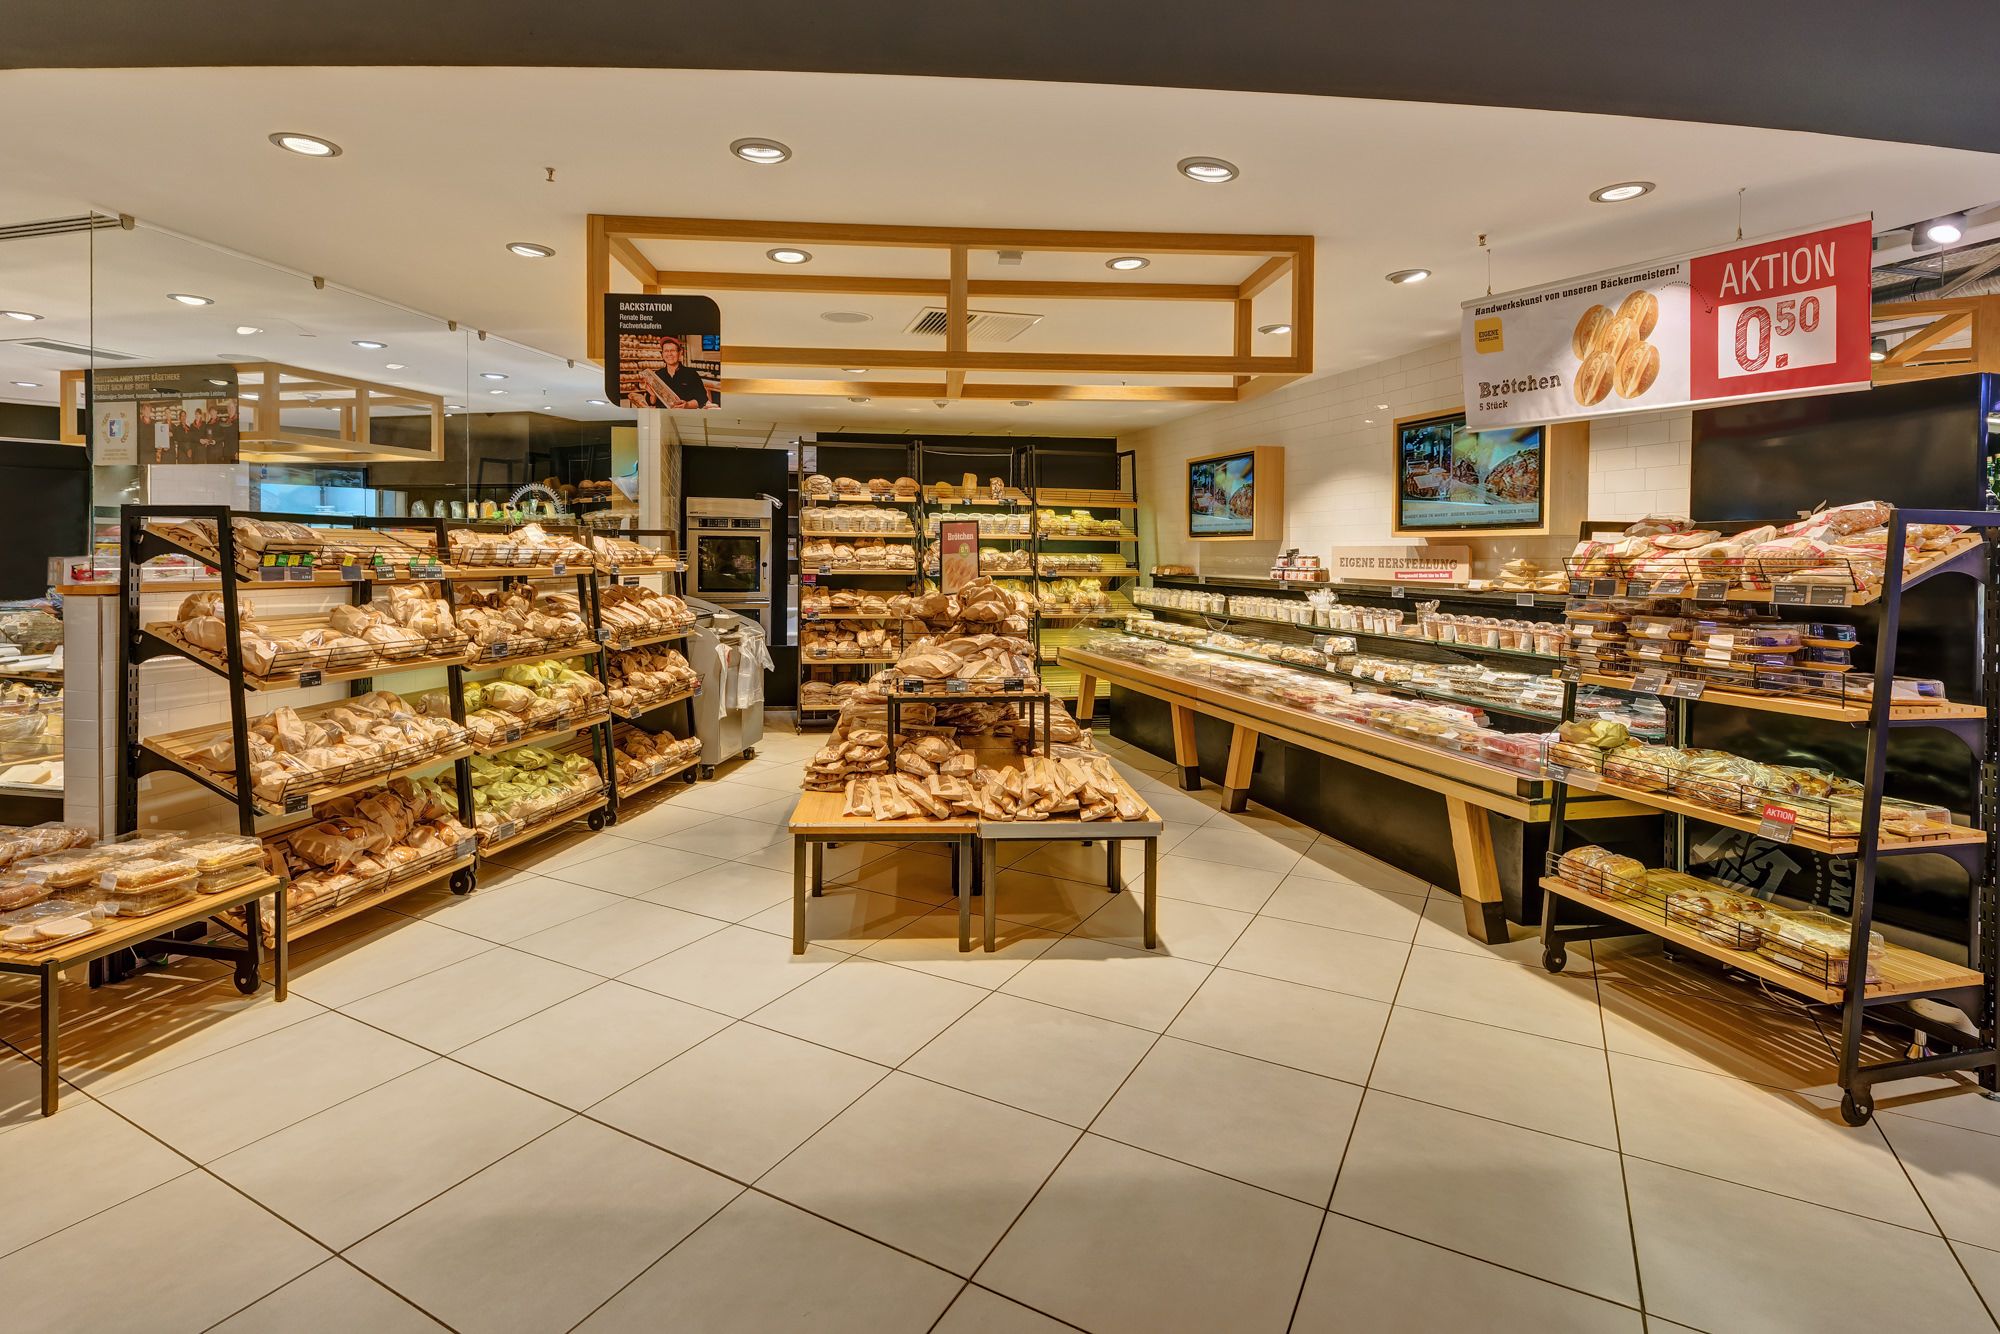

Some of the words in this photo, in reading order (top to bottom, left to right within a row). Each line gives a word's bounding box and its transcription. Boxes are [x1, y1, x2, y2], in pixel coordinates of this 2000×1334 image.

[1719, 242, 1836, 298] AKTION
[1475, 294, 1543, 316] Handwerkskunst
[1545, 291, 1560, 301] von
[1562, 284, 1598, 299] unseren
[1600, 264, 1680, 290] Bäckermeistern!
[620, 302, 673, 312] BACKSTATION
[620, 322, 662, 330] Fachverkäuferin
[134, 374, 151, 382] BESTE
[151, 372, 181, 381] KÄSETHEKE
[1479, 373, 1562, 399] Brötchen
[1479, 402, 1484, 411] 5
[1486, 400, 1508, 411] Stück
[947, 532, 974, 541] Brötchen
[1339, 557, 1375, 568] EIGENE
[1378, 558, 1458, 570] HERSTELLUNG
[1766, 807, 1794, 821] AKTION
